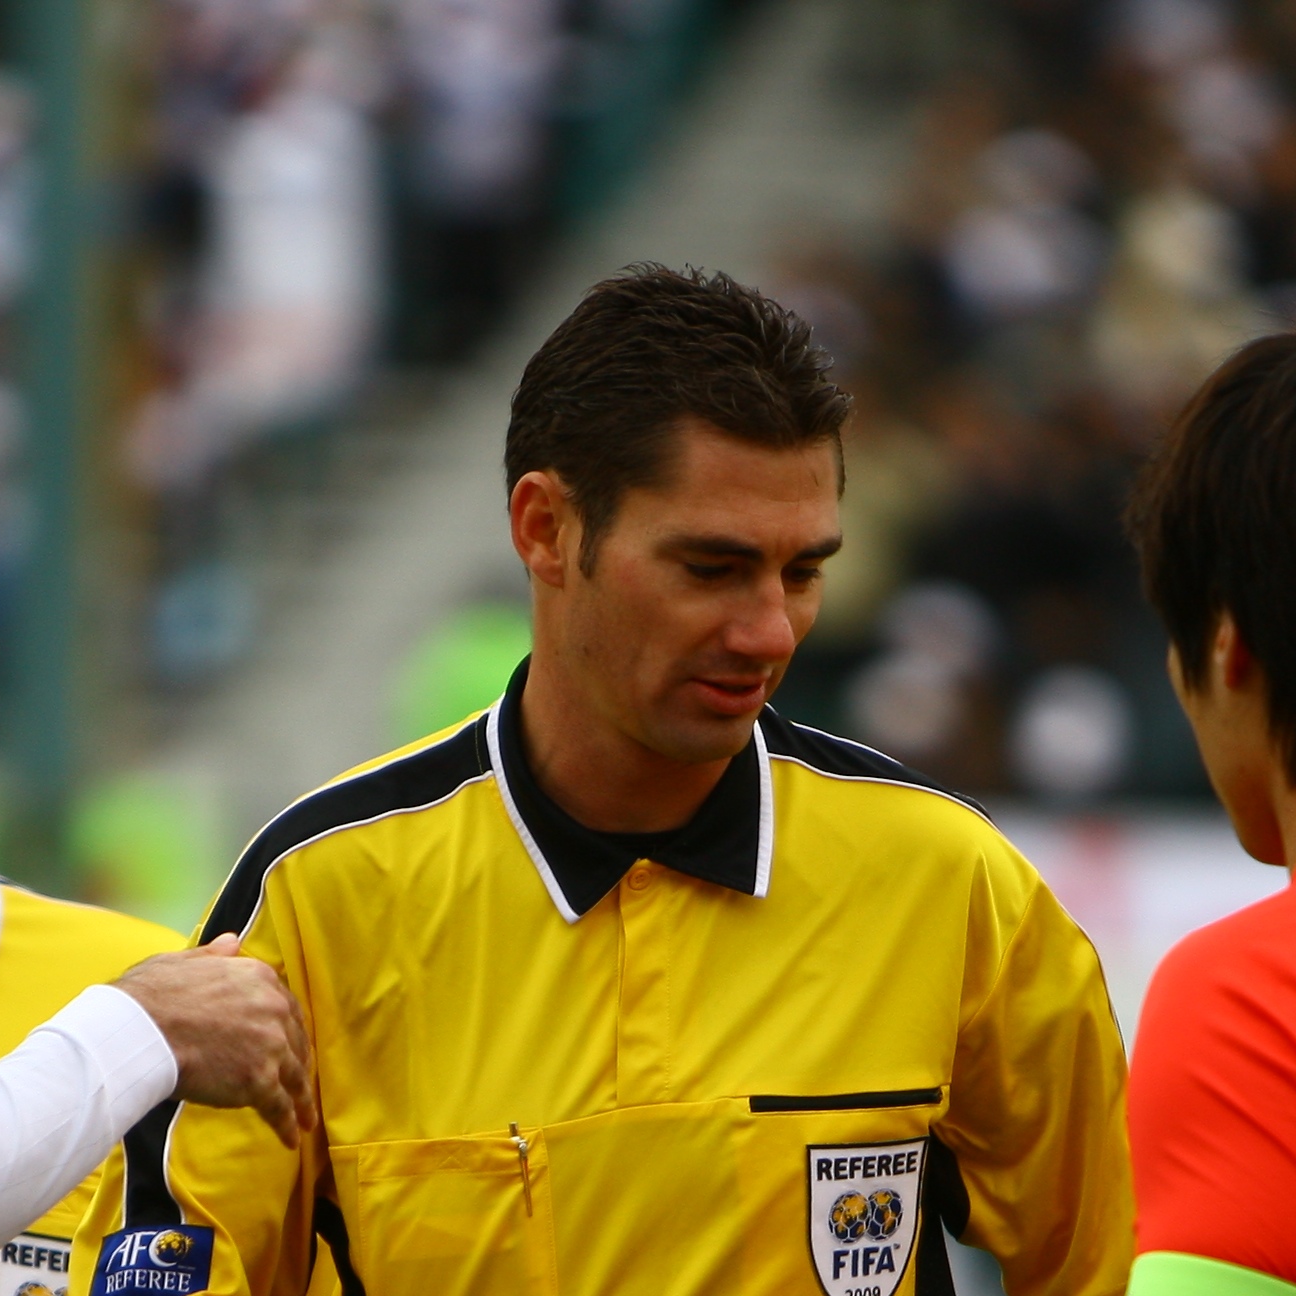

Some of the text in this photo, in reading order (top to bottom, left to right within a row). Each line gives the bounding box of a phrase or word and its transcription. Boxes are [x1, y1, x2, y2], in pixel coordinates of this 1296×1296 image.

[816, 1151, 919, 1181] REFEREE
[2, 1242, 70, 1274] REFE
[105, 1229, 179, 1273] AFC
[832, 1245, 896, 1280] FIFA
[105, 1268, 192, 1295] REFEREE
